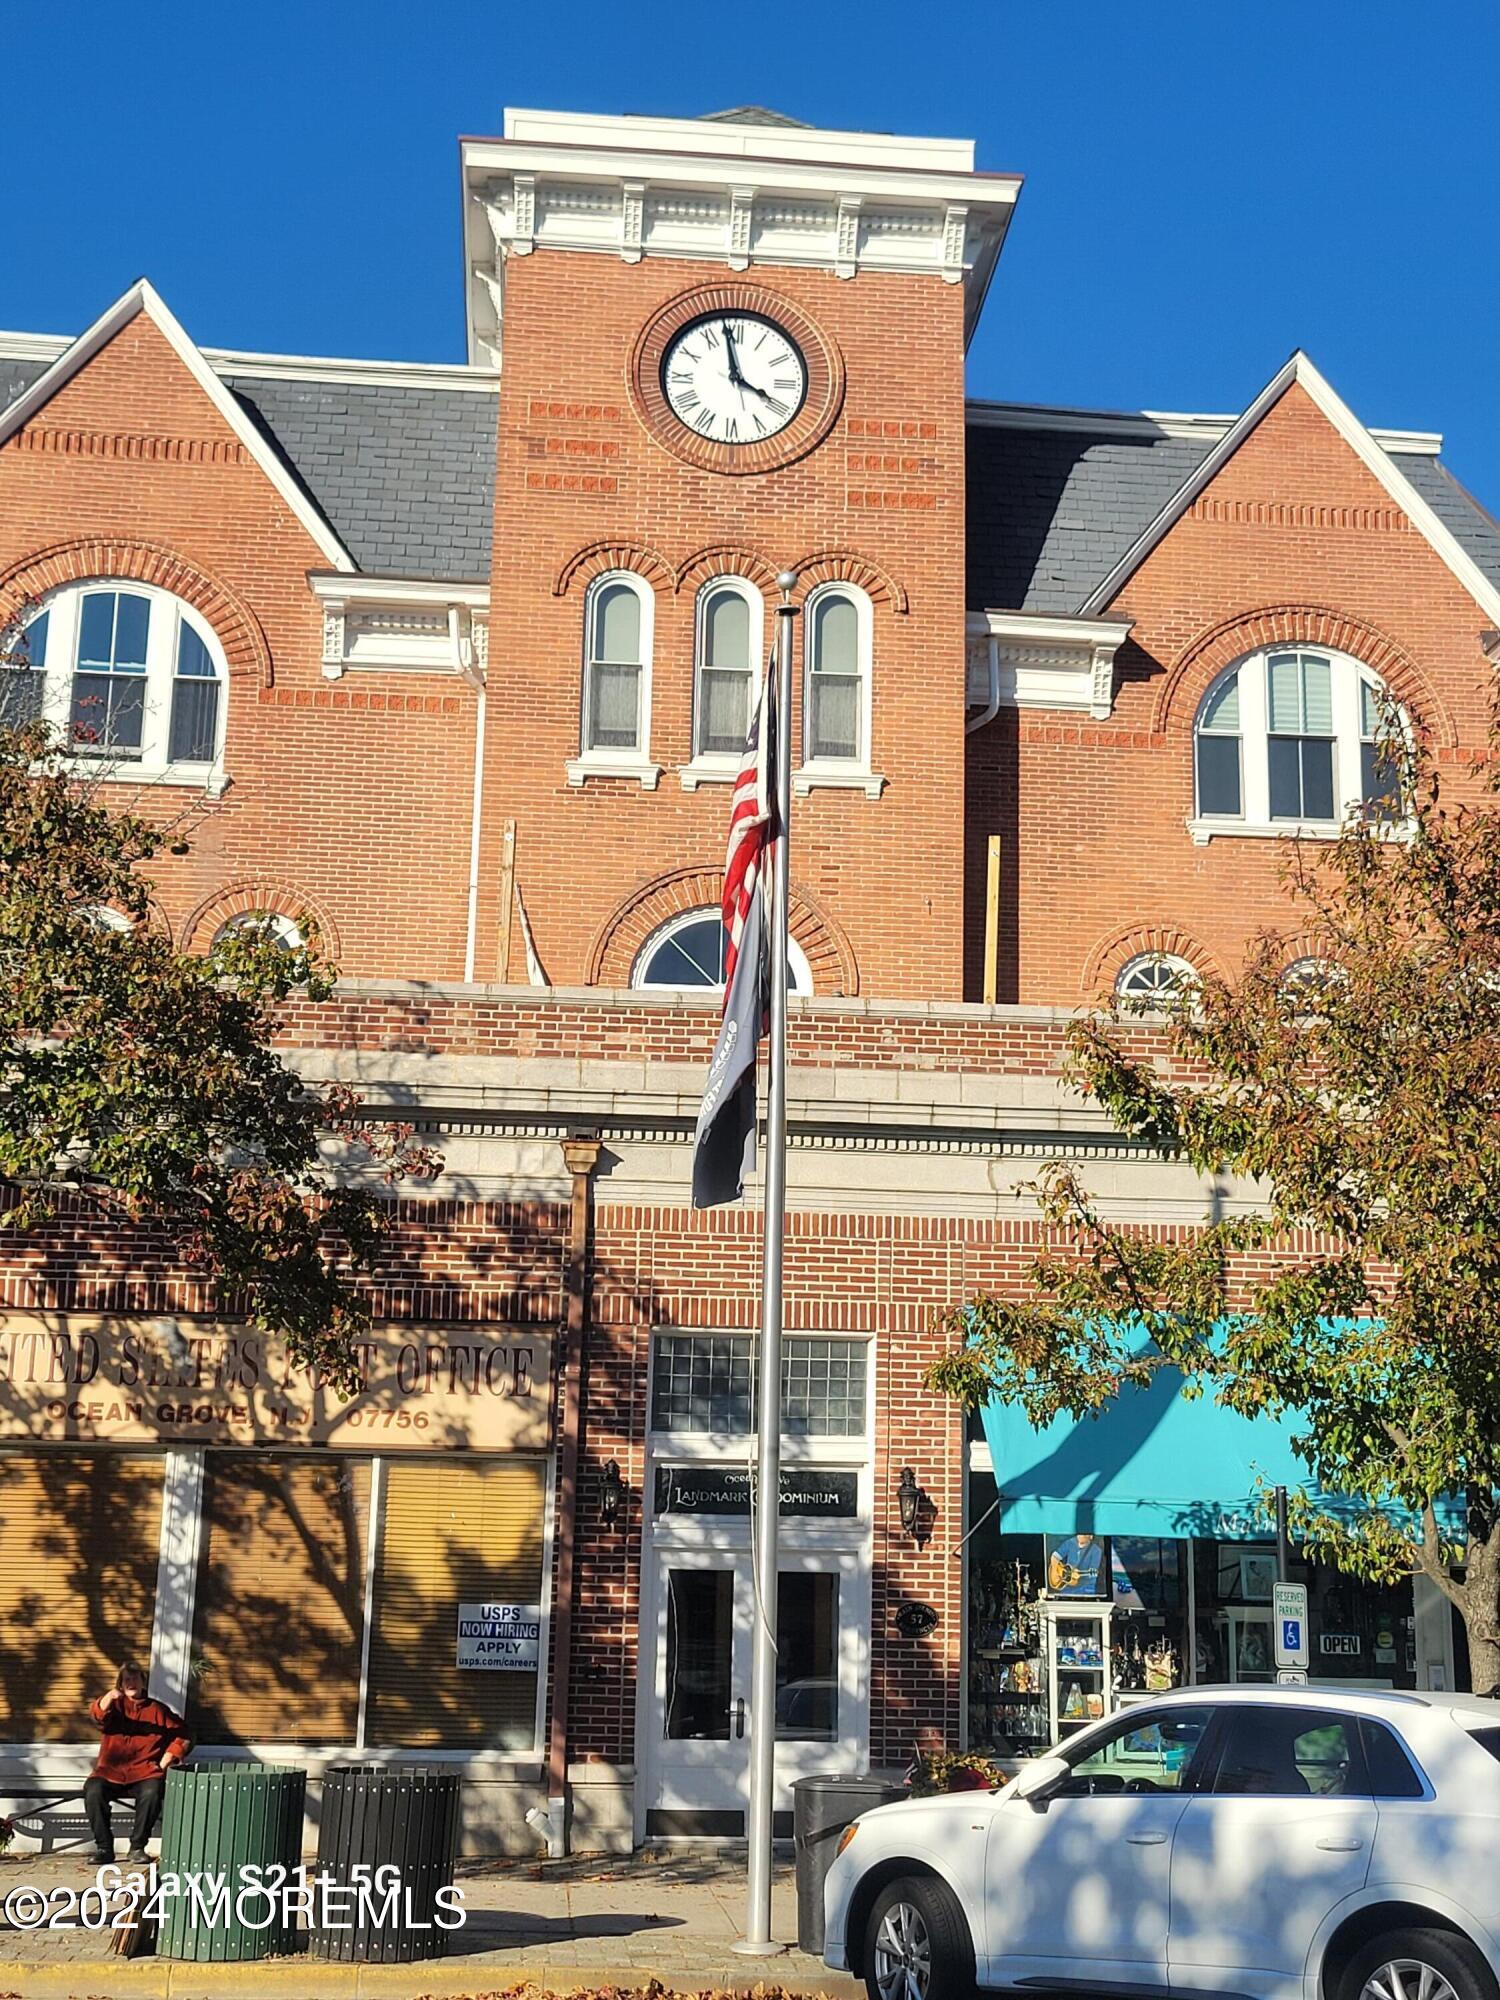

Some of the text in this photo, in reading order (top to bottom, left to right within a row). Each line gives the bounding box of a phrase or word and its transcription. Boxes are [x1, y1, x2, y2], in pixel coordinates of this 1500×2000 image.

[0, 1332, 100, 1385] ITED
[280, 1343, 378, 1393] POT
[395, 1344, 534, 1398] OFFICE
[47, 1400, 429, 1429] OCEAN GROVE, N.J. 07756
[751, 1488, 840, 1505] COMINIUM
[1276, 1590, 1304, 1603] RESERVED
[481, 1606, 521, 1621] USPS
[1278, 1605, 1303, 1617] PARKING
[911, 1613, 924, 1625] 57
[461, 1622, 538, 1638] NOW HIRING
[475, 1641, 522, 1654] APPLY
[1323, 1636, 1358, 1653] OPEN
[458, 1657, 537, 1668] usps.com/careers
